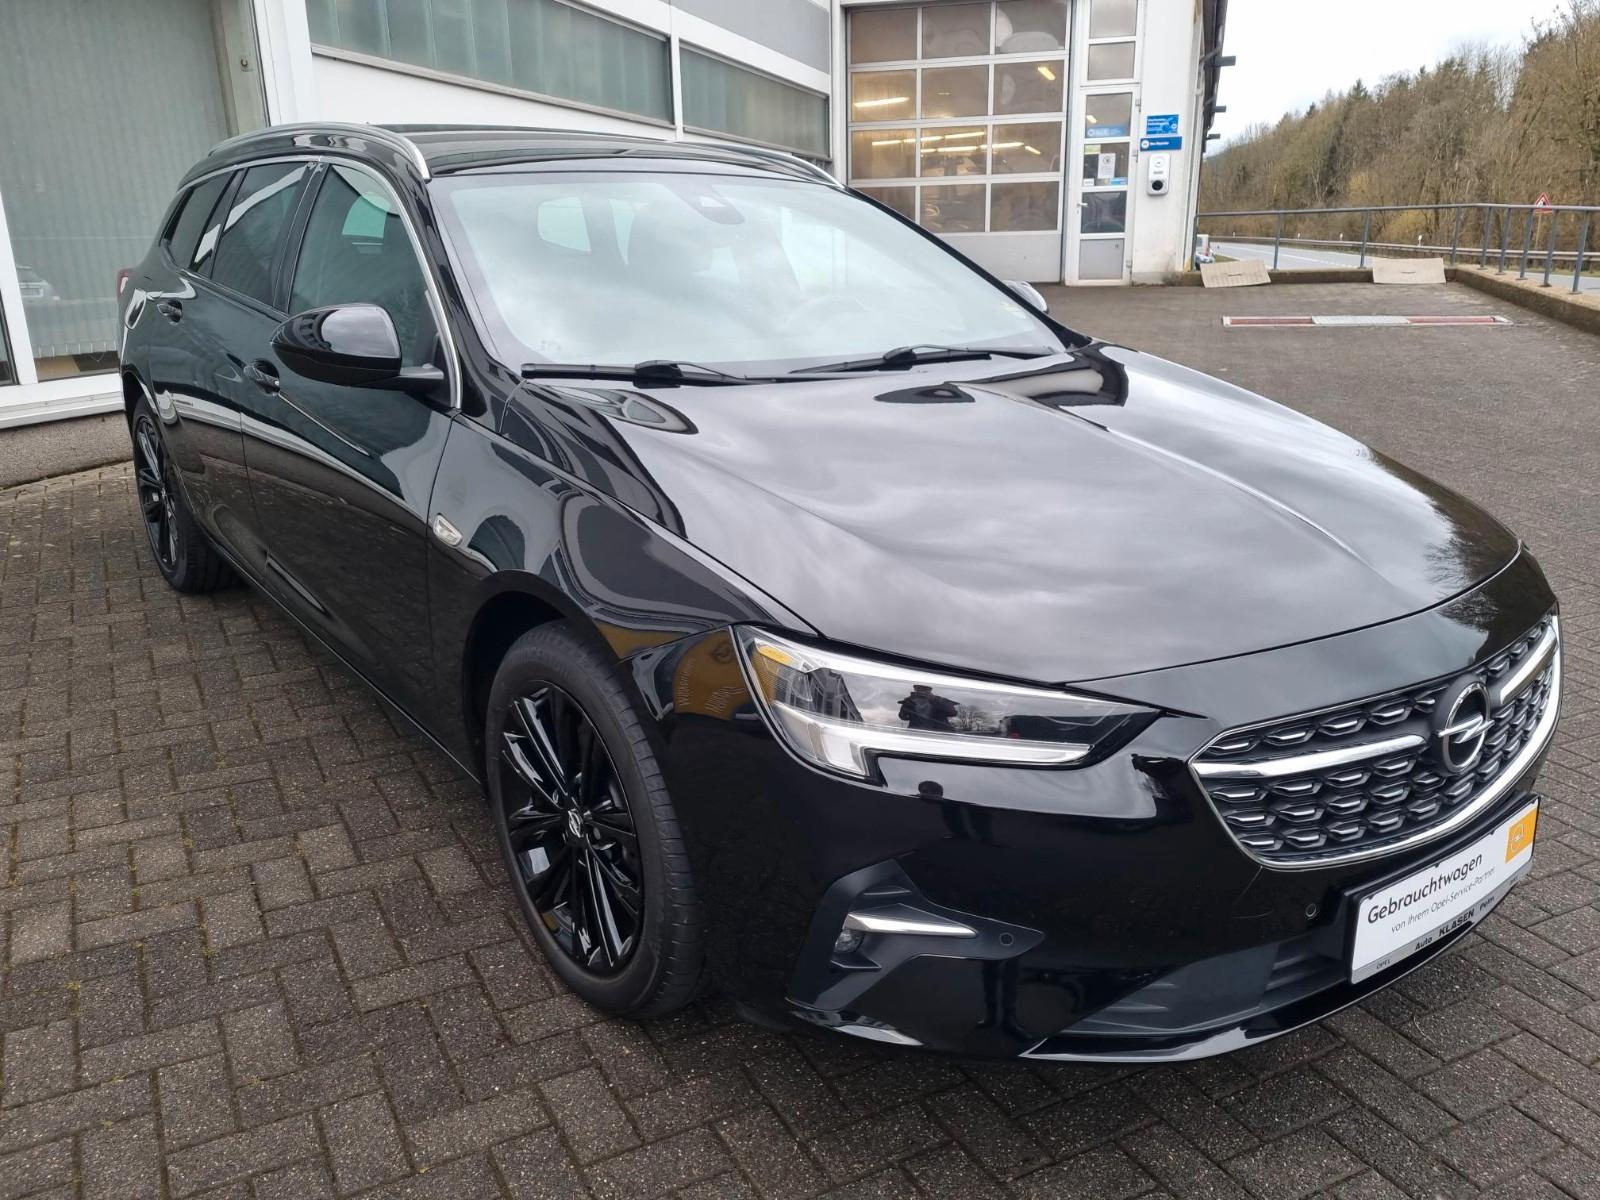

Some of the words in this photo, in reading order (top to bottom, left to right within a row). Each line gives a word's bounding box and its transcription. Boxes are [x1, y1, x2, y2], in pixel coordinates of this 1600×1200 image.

[1368, 853, 1482, 924] Gebrauchtwagen
[1391, 921, 1406, 933] von
[1415, 937, 1433, 951] Auto
[1439, 908, 1475, 937] KLASEN
